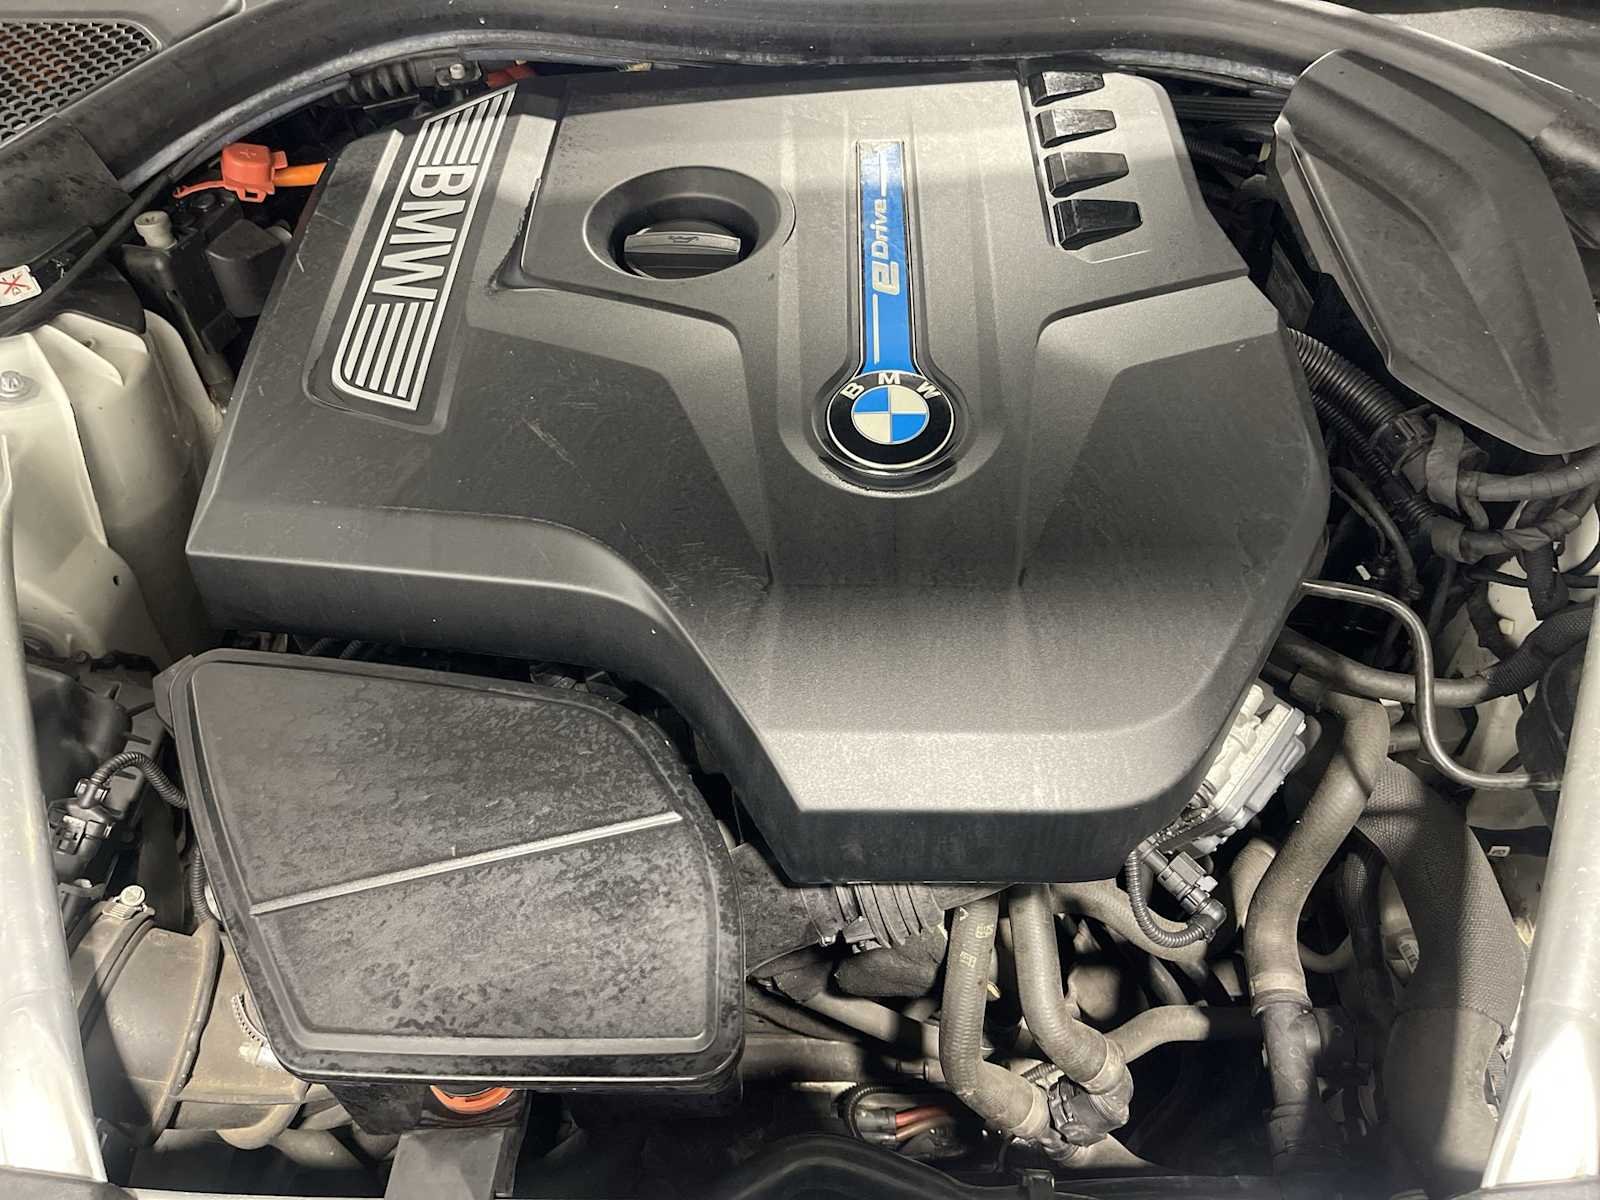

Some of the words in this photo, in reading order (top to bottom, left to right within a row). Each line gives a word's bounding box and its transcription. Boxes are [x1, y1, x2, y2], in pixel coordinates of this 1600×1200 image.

[371, 164, 479, 301] BMW
[869, 198, 900, 296] eDrive
[840, 371, 942, 401] BMW
